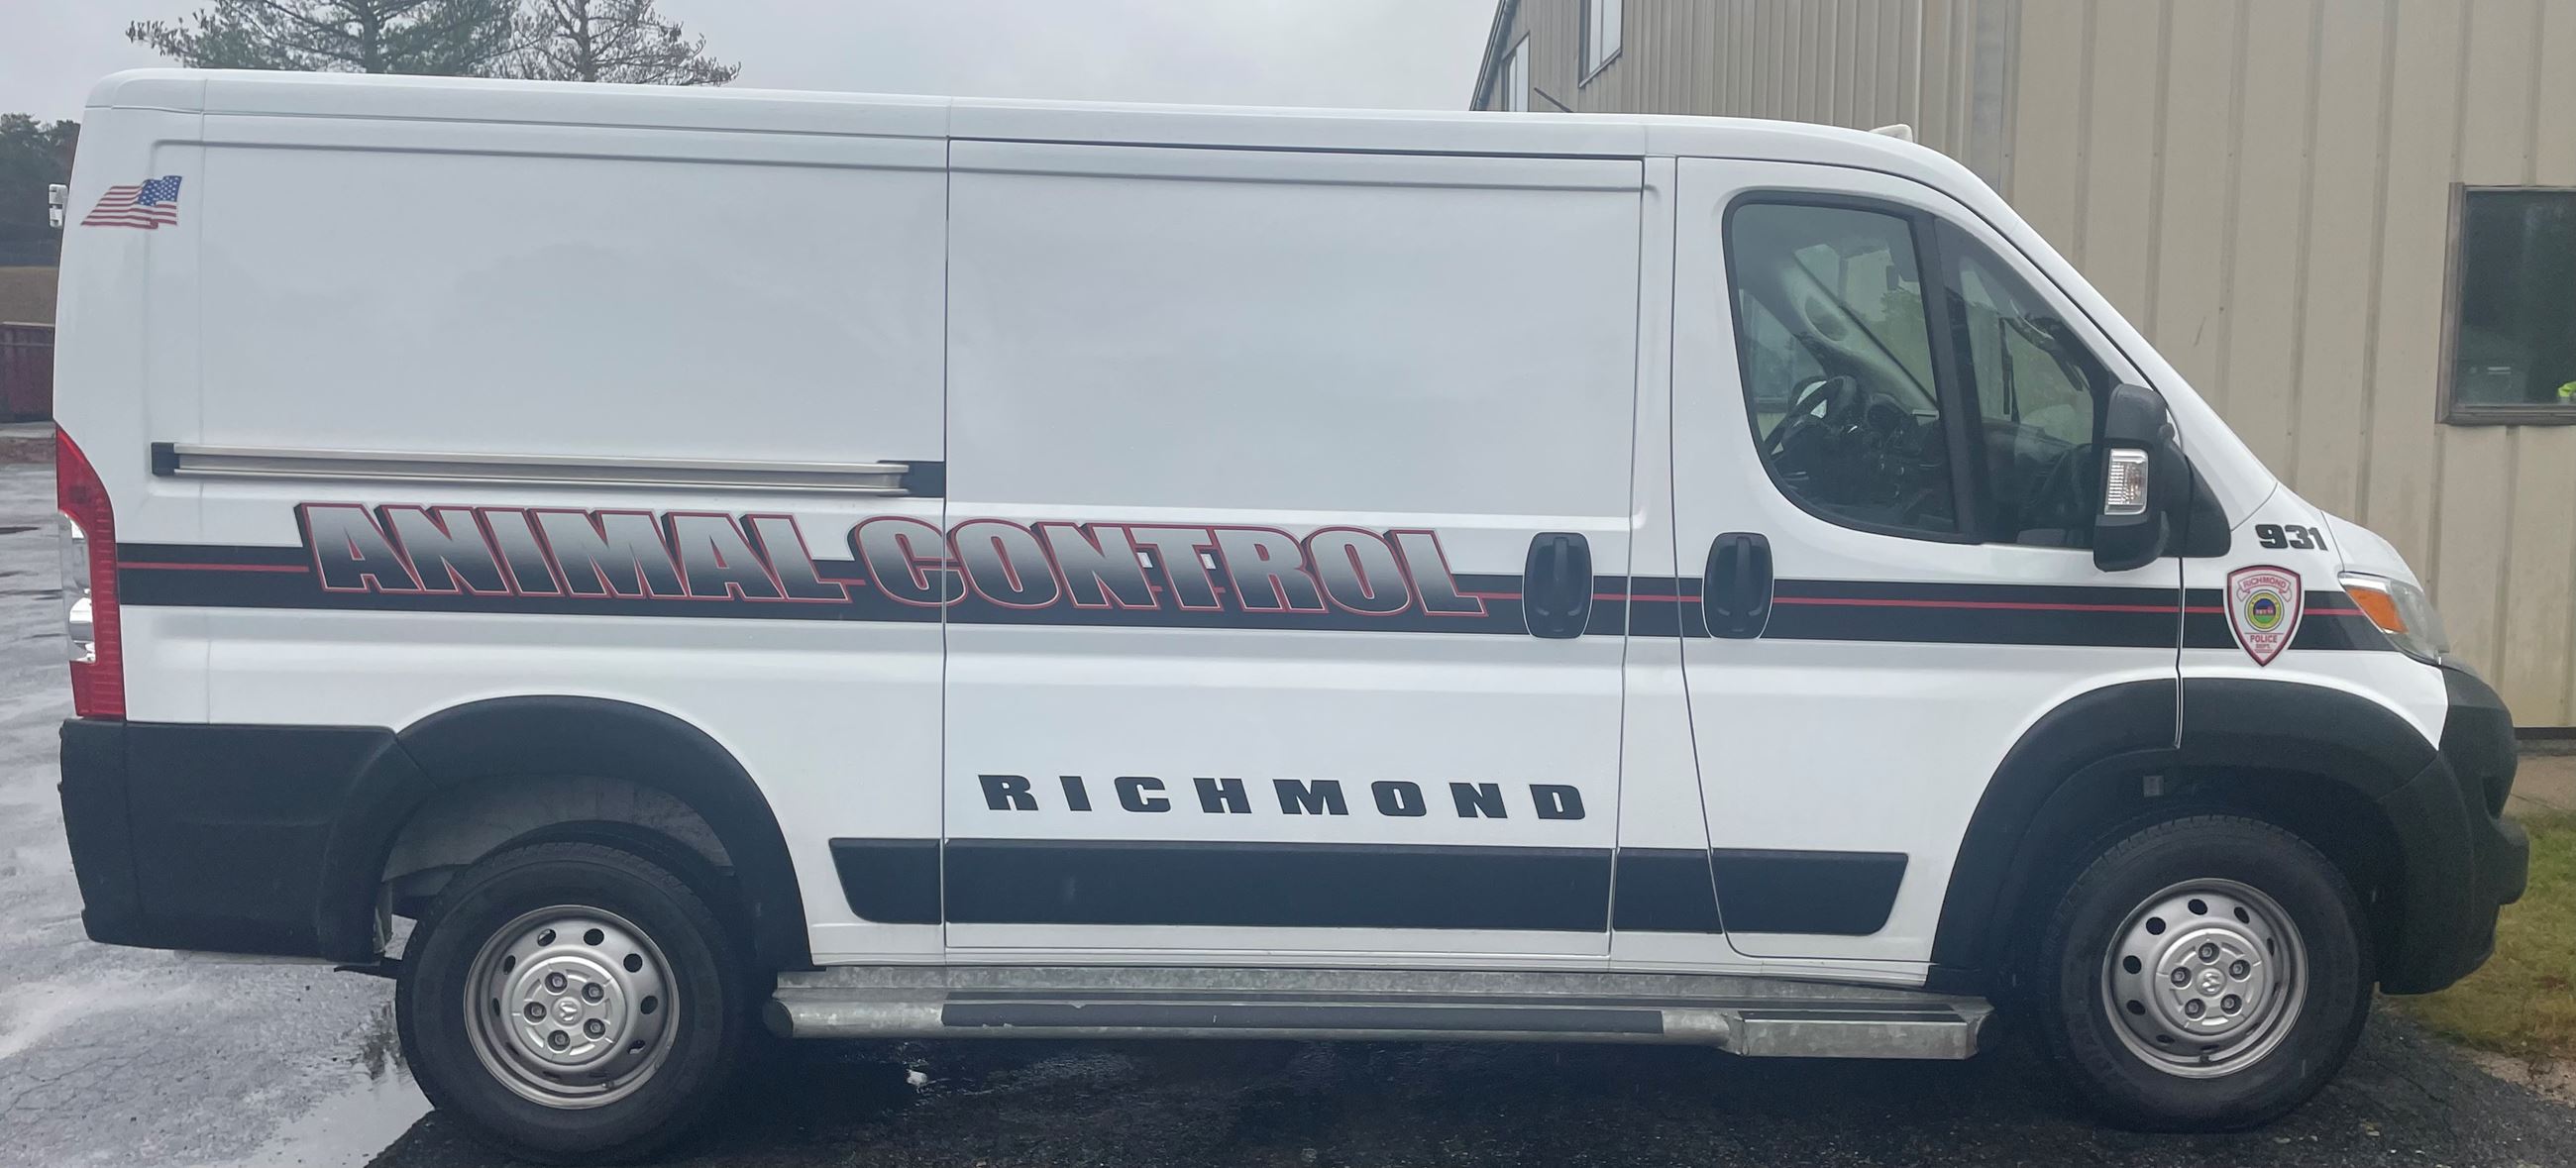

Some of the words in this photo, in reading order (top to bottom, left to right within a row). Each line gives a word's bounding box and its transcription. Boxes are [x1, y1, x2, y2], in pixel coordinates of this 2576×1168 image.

[2255, 524, 2328, 551] 931
[294, 501, 852, 603] ANIMAL
[847, 515, 1488, 616] CONTROL
[2243, 576, 2286, 588] RICHMOND
[2250, 634, 2278, 643] POLICE
[978, 775, 1585, 820] RICHMOND
